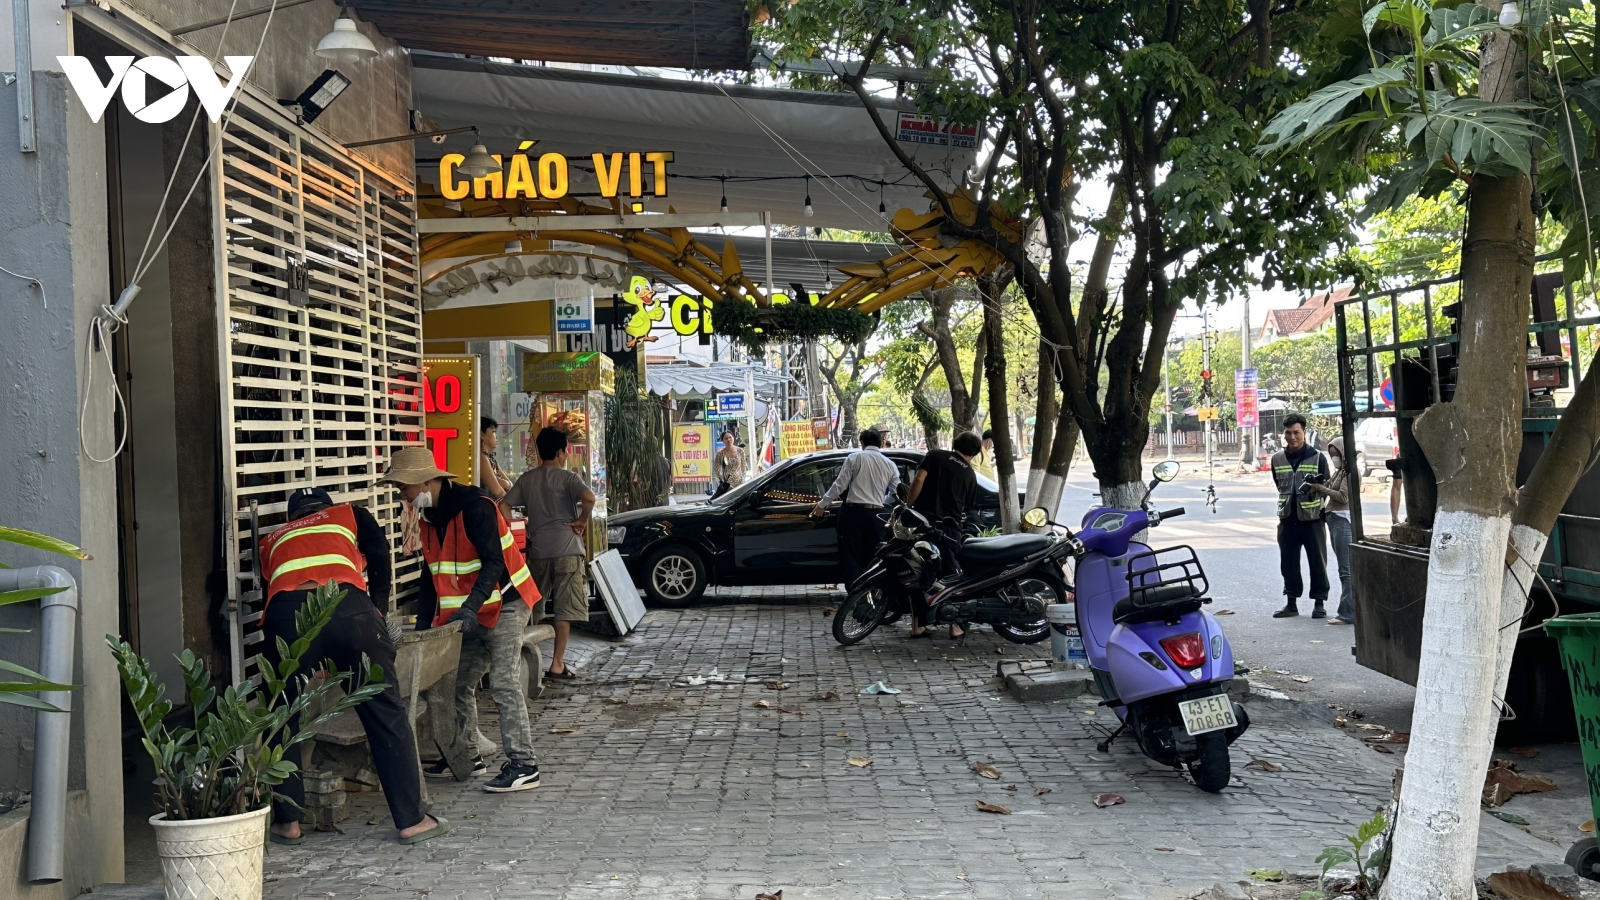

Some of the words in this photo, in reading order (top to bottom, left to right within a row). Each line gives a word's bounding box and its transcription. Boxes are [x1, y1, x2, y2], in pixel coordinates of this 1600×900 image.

[439, 139, 569, 200] CHÁO
[591, 150, 674, 214] VỊT
[1188, 697, 1223, 716] 43-E1
[1188, 711, 1234, 731] 208.68
